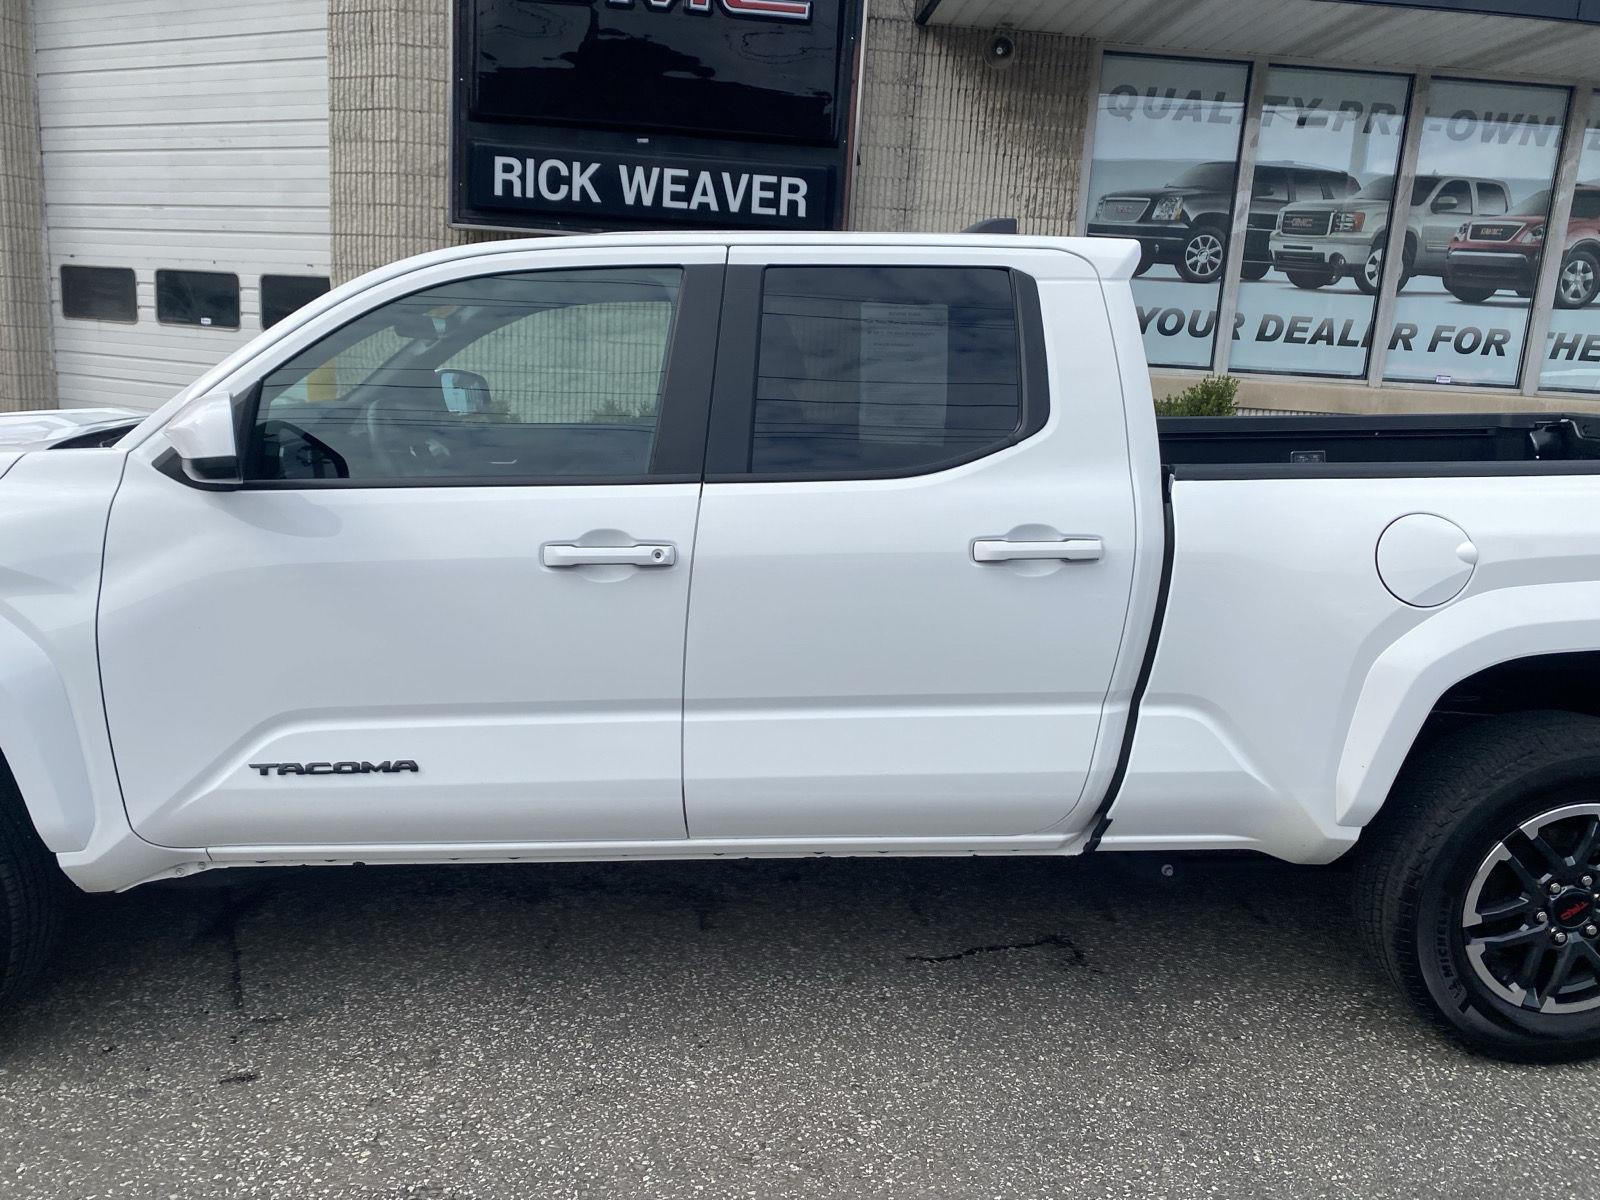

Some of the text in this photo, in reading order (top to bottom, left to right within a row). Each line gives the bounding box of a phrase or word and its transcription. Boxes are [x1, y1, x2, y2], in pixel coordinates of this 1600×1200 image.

[1106, 84, 1324, 129] QUALTY
[493, 155, 809, 218] RICK WEAVER
[1254, 313, 1418, 352] DEALR
[1427, 324, 1511, 357] FOR
[248, 759, 419, 776] TACOMA
